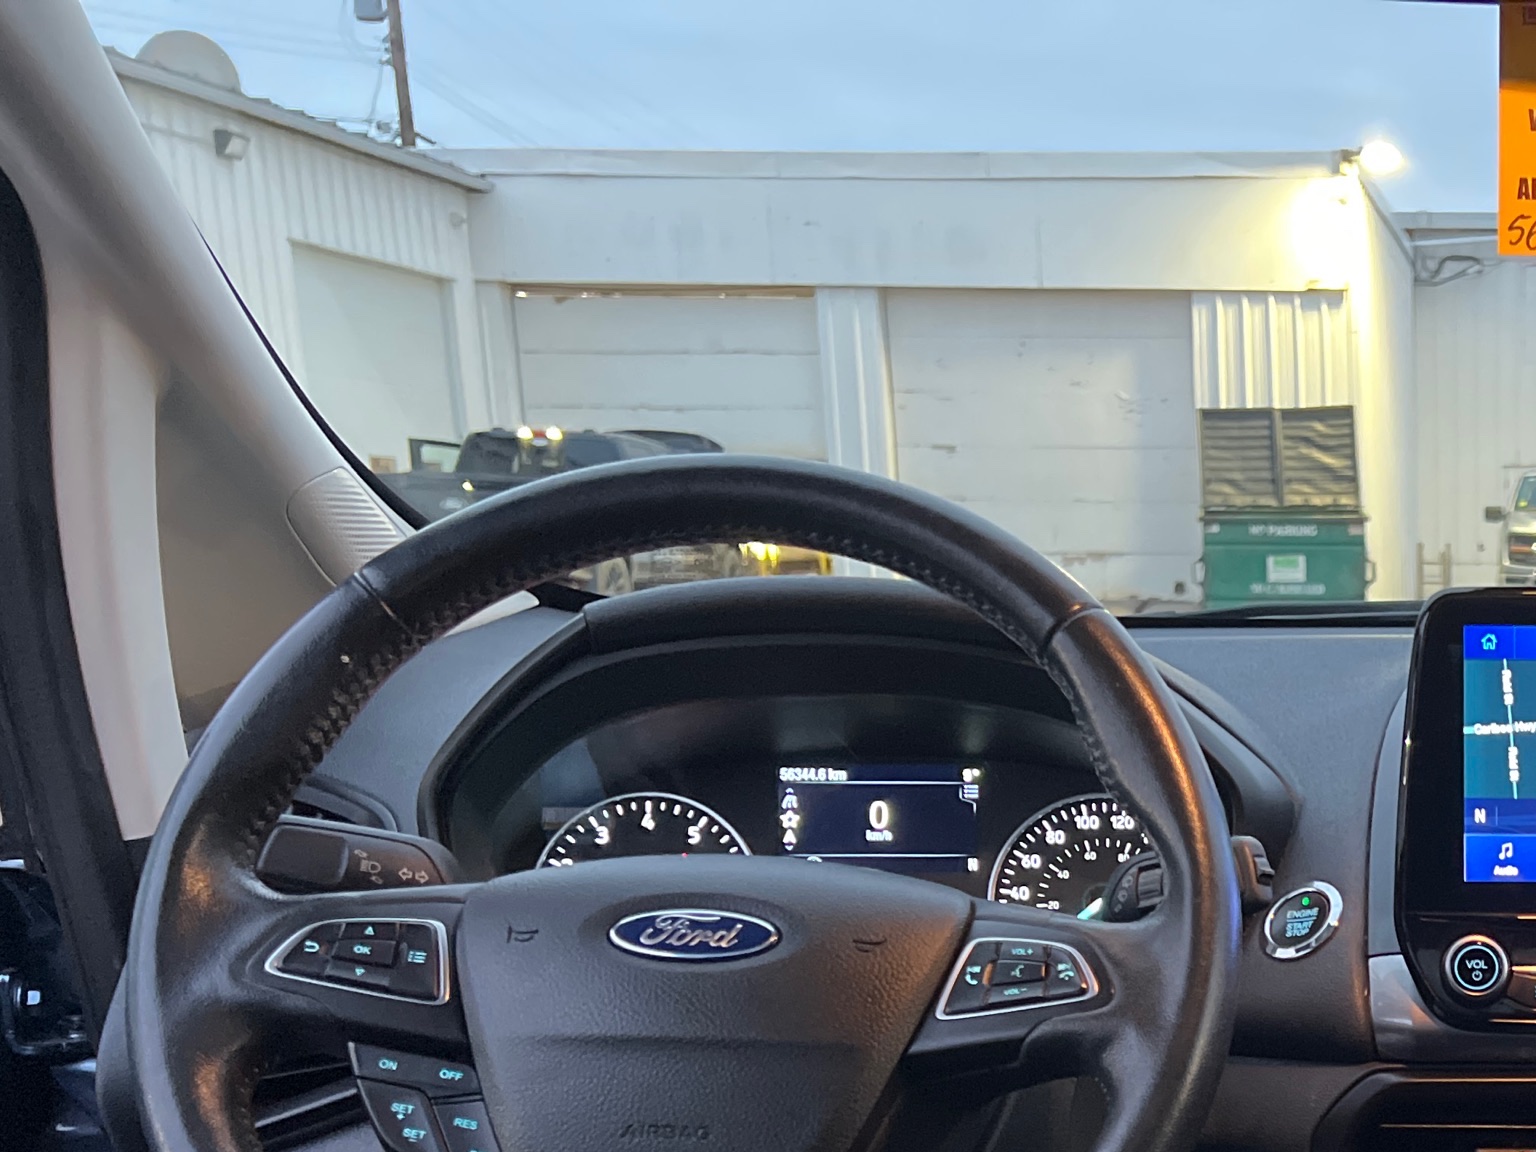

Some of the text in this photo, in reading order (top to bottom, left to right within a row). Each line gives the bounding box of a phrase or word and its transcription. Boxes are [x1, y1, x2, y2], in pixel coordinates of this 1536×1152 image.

[779, 767, 848, 781] 56344.6 km
[640, 812, 656, 831] 4
[869, 800, 890, 830] 0
[1474, 808, 1486, 823] N
[1074, 815, 1100, 830] 100
[1110, 815, 1135, 830] 120
[594, 826, 610, 845] 3
[687, 825, 701, 845] 5
[865, 829, 893, 842] km/h
[1045, 830, 1066, 845] 80
[1021, 854, 1041, 869] 60
[1083, 851, 1097, 861] 60
[1057, 869, 1070, 879] 40
[1010, 886, 1030, 900] 40
[1047, 900, 1060, 910] 20
[1286, 907, 1320, 918] ENGINE
[638, 914, 743, 948] Ford
[1286, 920, 1314, 931] START
[1285, 928, 1310, 938] STOP
[353, 945, 372, 955] OK
[1465, 960, 1488, 970] VOL
[378, 1059, 398, 1071] ON
[439, 1069, 464, 1081] OFF
[390, 1102, 416, 1115] SET
[453, 1117, 478, 1130] RES
[402, 1127, 427, 1140] SET
